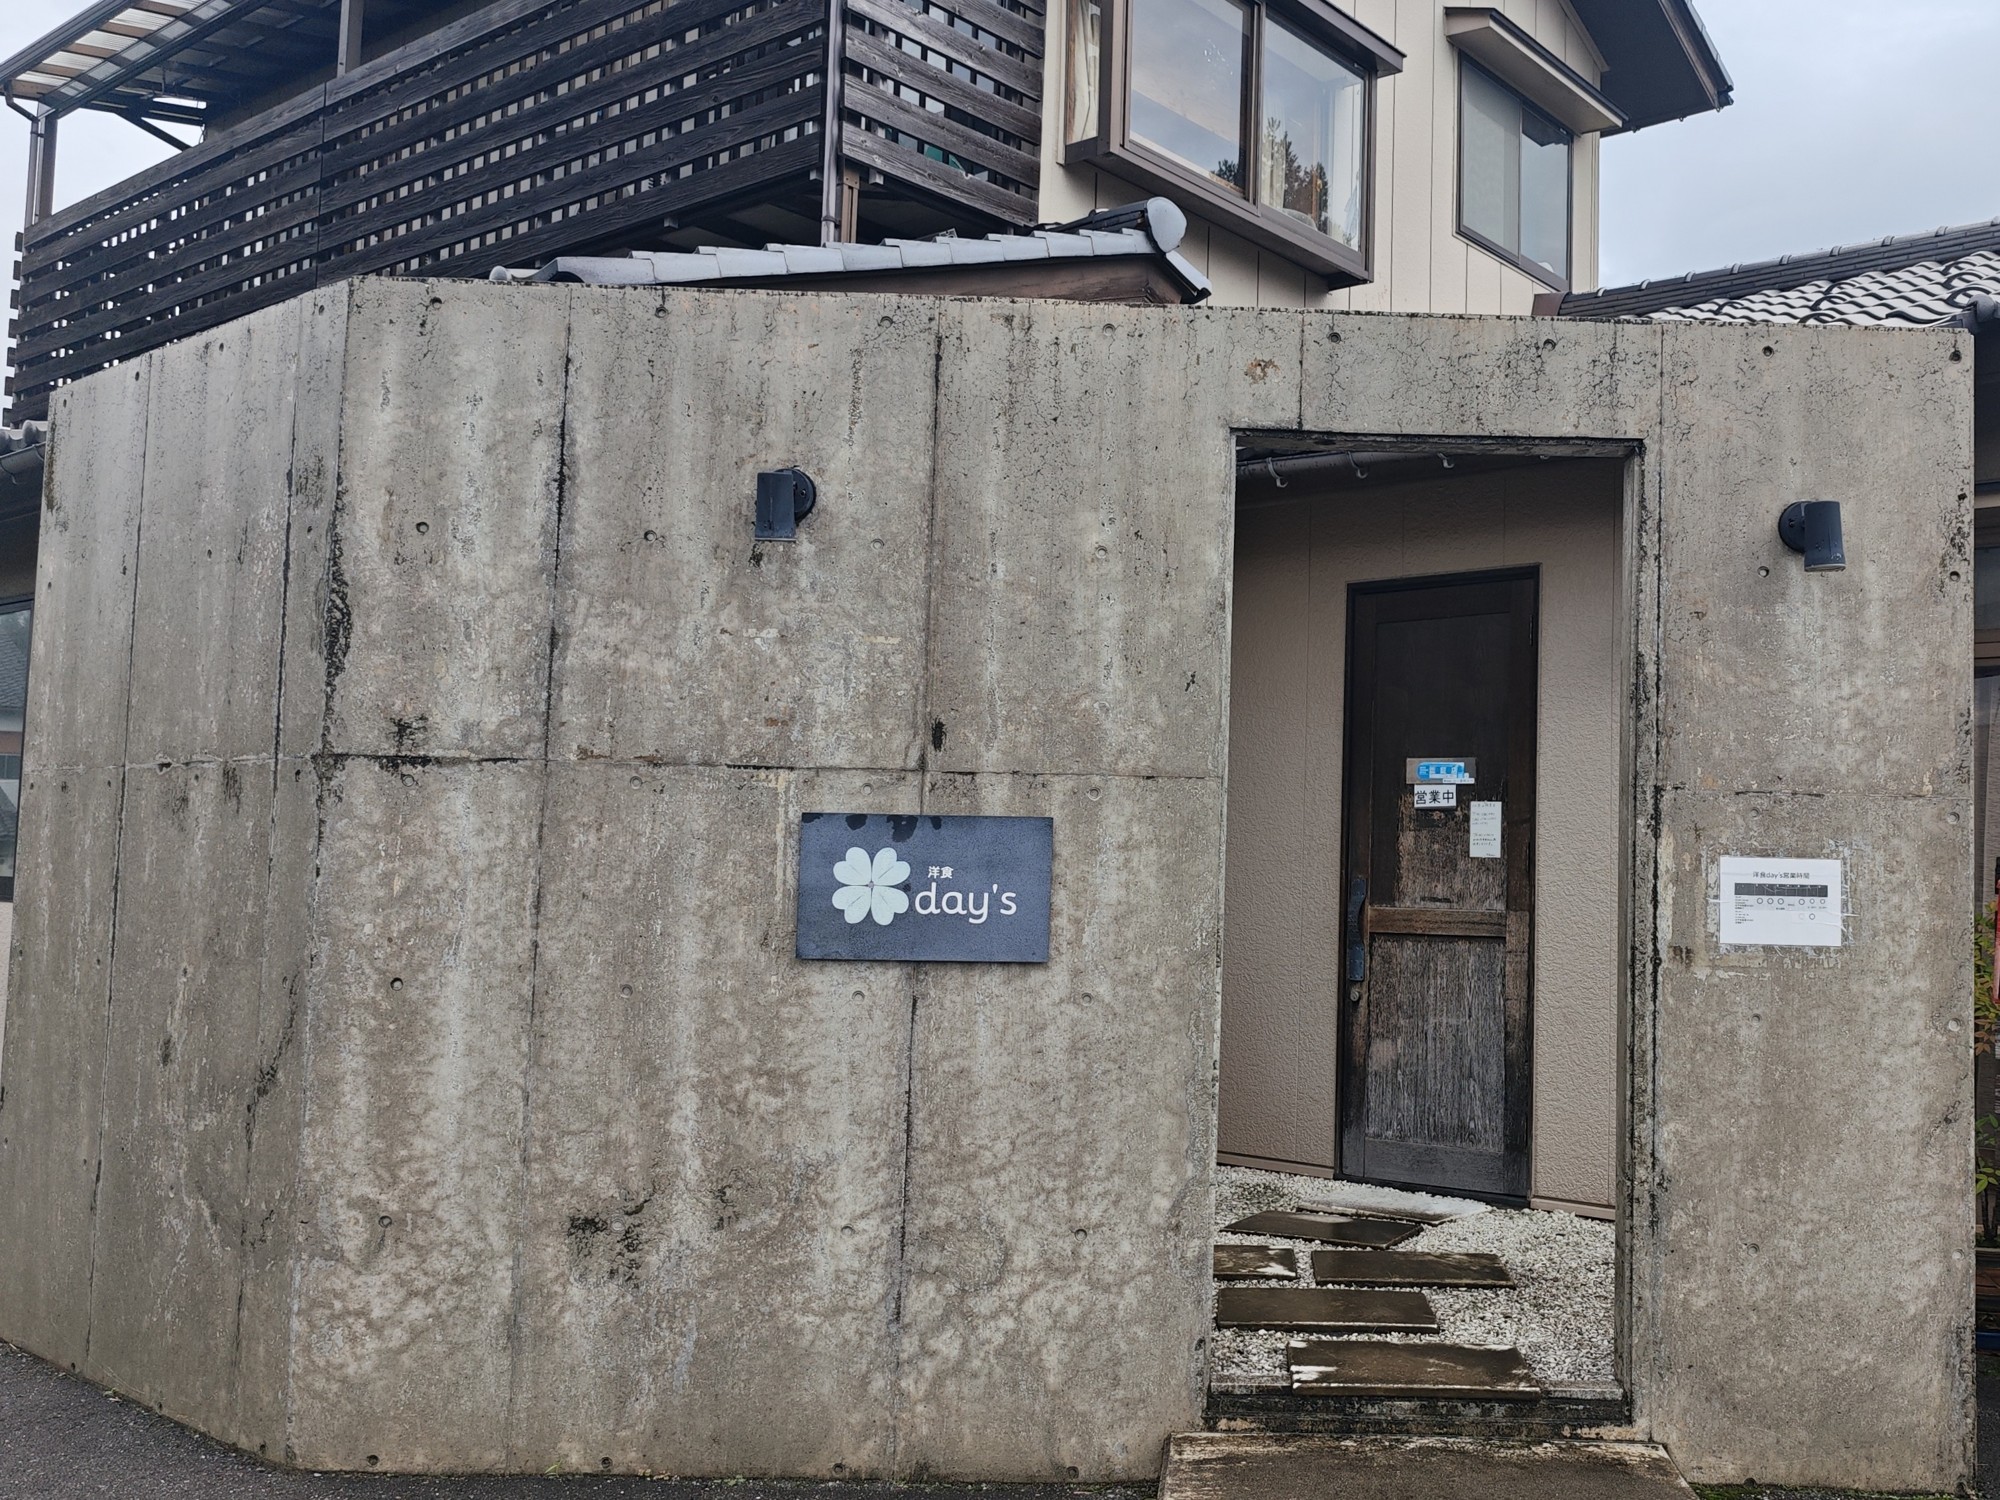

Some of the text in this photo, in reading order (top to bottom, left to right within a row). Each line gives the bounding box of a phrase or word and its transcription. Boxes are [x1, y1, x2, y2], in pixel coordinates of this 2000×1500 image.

[1415, 789, 1454, 805] 営業中
[927, 866, 954, 879] 洋食
[915, 882, 1017, 924] day's
